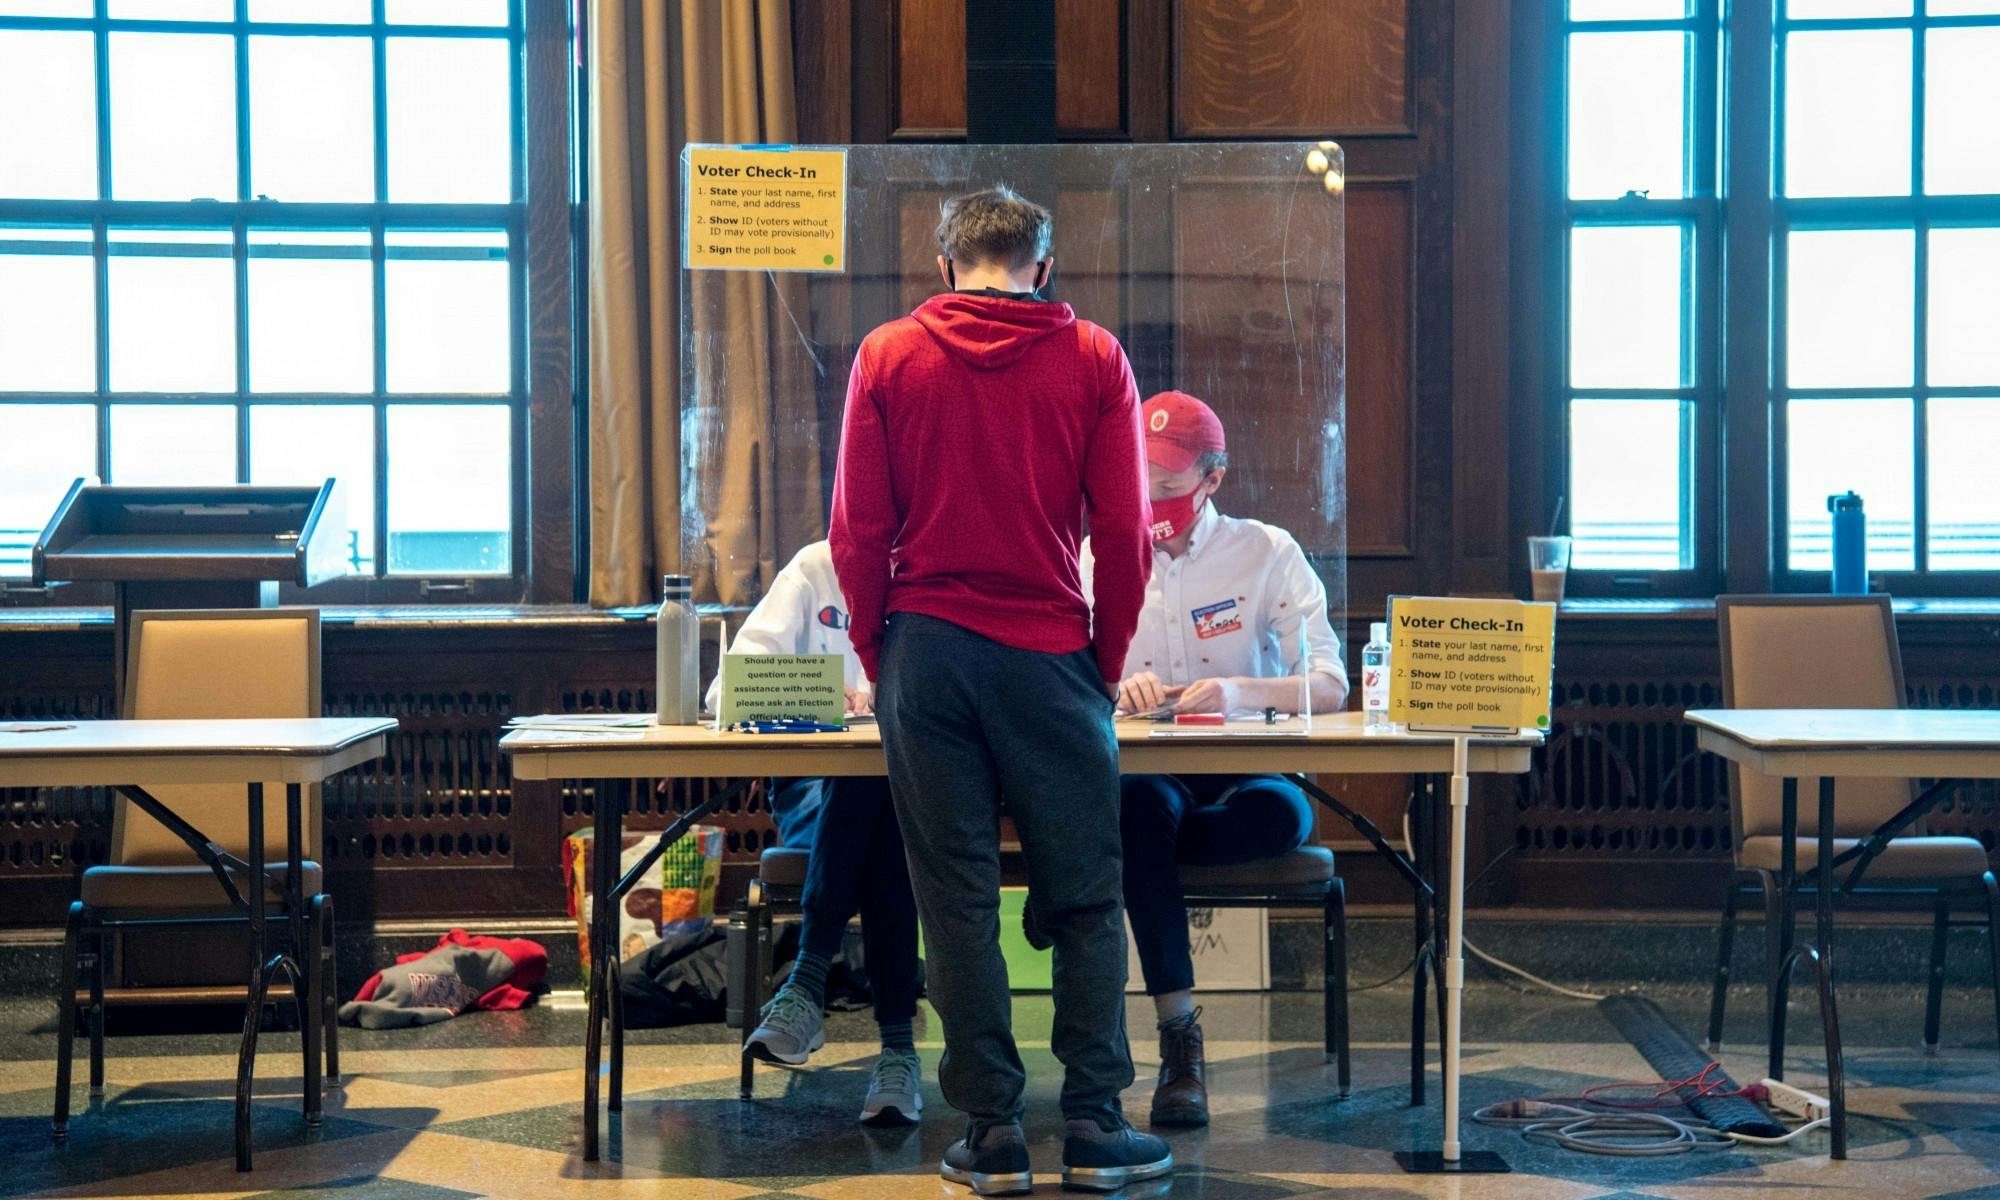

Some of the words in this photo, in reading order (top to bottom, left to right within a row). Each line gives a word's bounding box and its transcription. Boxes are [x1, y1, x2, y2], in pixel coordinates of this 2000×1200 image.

[698, 165, 740, 176] Voter
[746, 166, 816, 178] Check-In
[710, 187, 738, 196] State
[741, 190, 762, 198] your
[766, 189, 781, 197] last
[786, 190, 814, 198] name,
[818, 190, 836, 198] first
[744, 200, 760, 208] and
[764, 200, 800, 208] address
[697, 216, 705, 224] 2.
[710, 217, 738, 225] Show
[757, 218, 789, 226] (voters
[772, 230, 834, 239] provisionally)
[709, 246, 732, 255] Sign
[754, 247, 770, 255] poll
[774, 247, 796, 255] book
[1152, 526, 1175, 540] TE
[1401, 616, 1444, 629] Voter
[1450, 618, 1523, 632] Check-In
[1412, 640, 1440, 648] State
[1445, 642, 1465, 651] your
[1470, 641, 1487, 650] last
[1491, 644, 1520, 652] name,
[1525, 644, 1544, 652] first
[1412, 653, 1442, 661] name,
[1447, 652, 1464, 661] and
[1468, 653, 1506, 663] address
[1411, 669, 1440, 678] Show
[1445, 671, 1456, 679] ID
[1460, 671, 1494, 681] (voters
[1498, 673, 1534, 682] without
[1411, 682, 1422, 690] ID
[1426, 683, 1446, 692] may
[1451, 683, 1471, 692] vote
[1475, 684, 1540, 696] provisionally)
[1410, 700, 1433, 709] Sign
[1437, 701, 1452, 710] the
[1457, 701, 1473, 711] poll
[1477, 702, 1500, 711] book
